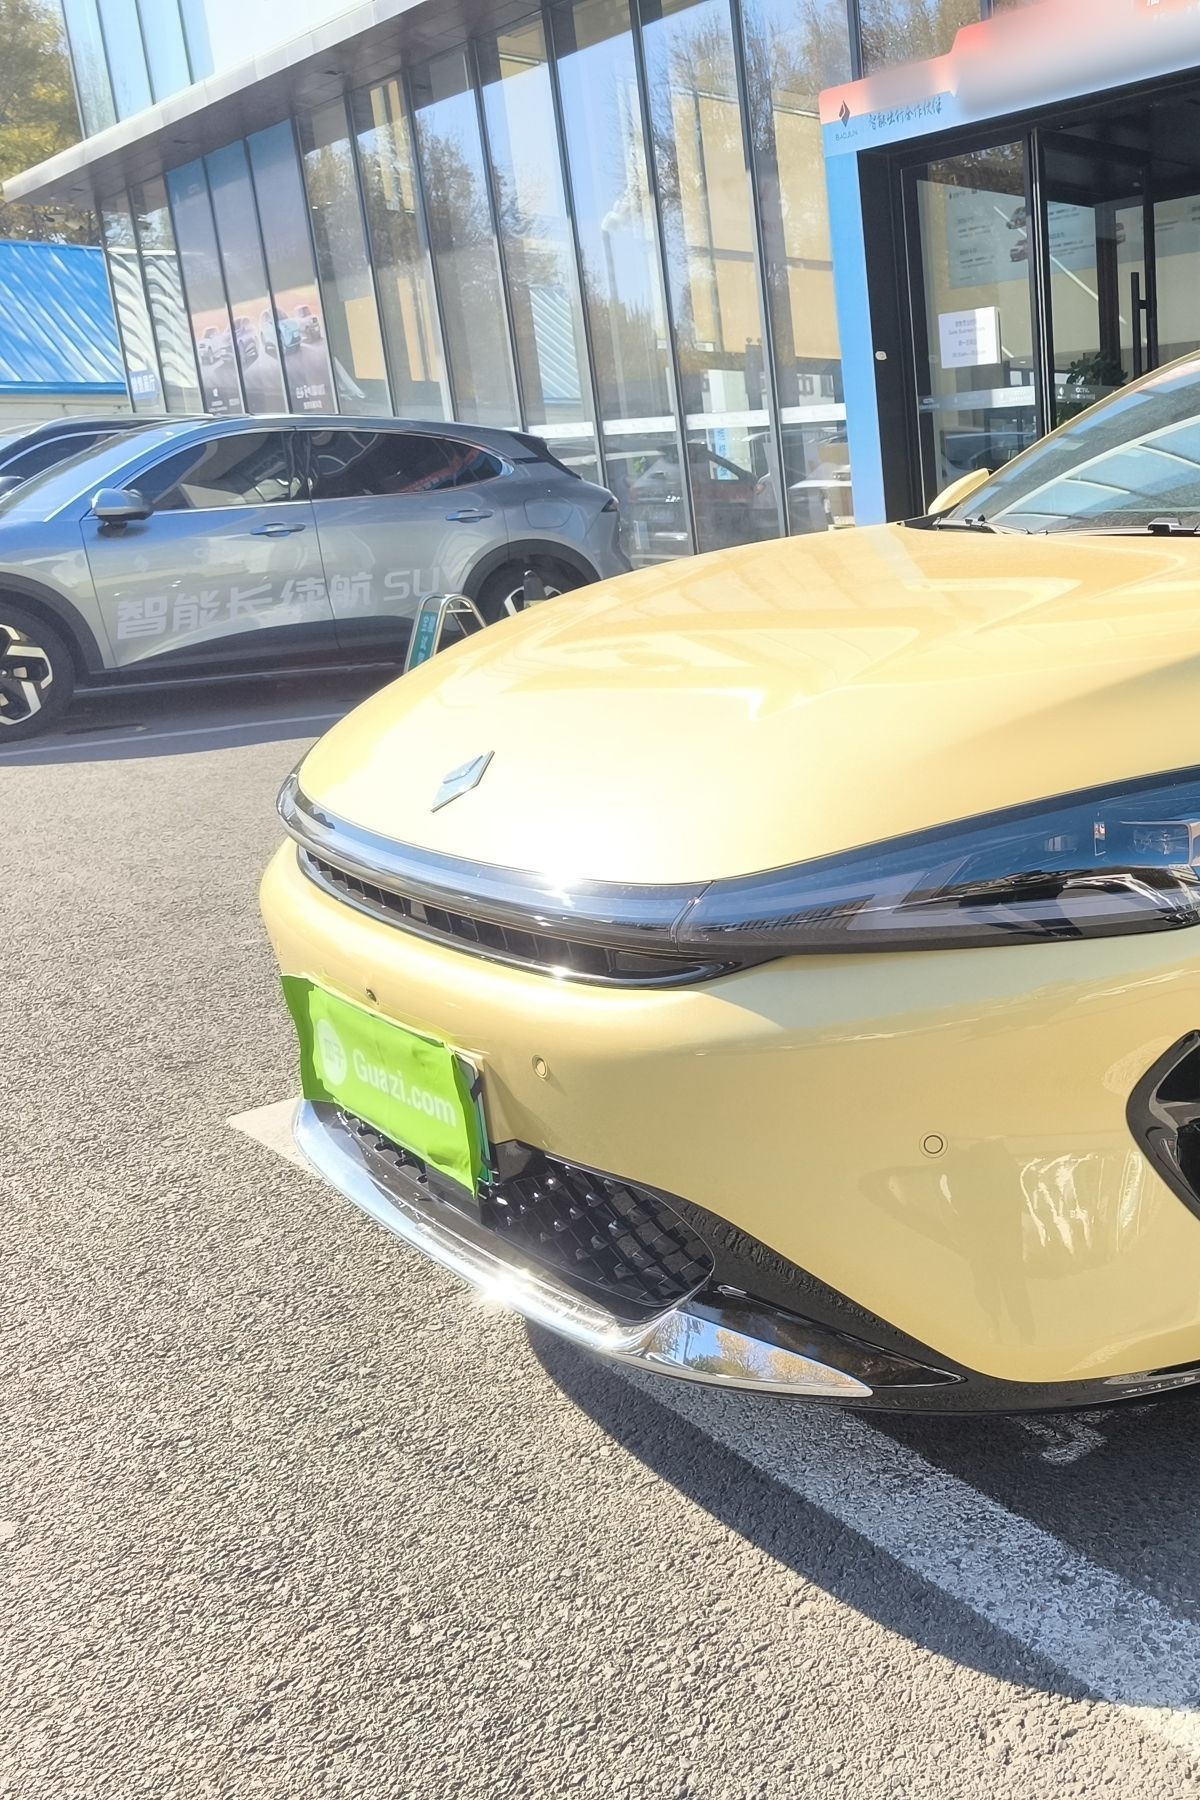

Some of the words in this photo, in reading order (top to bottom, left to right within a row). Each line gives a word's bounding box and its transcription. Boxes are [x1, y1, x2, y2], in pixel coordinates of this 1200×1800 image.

[117, 574, 373, 640] 智能长续航
[352, 1048, 457, 1128] Guazi.com
